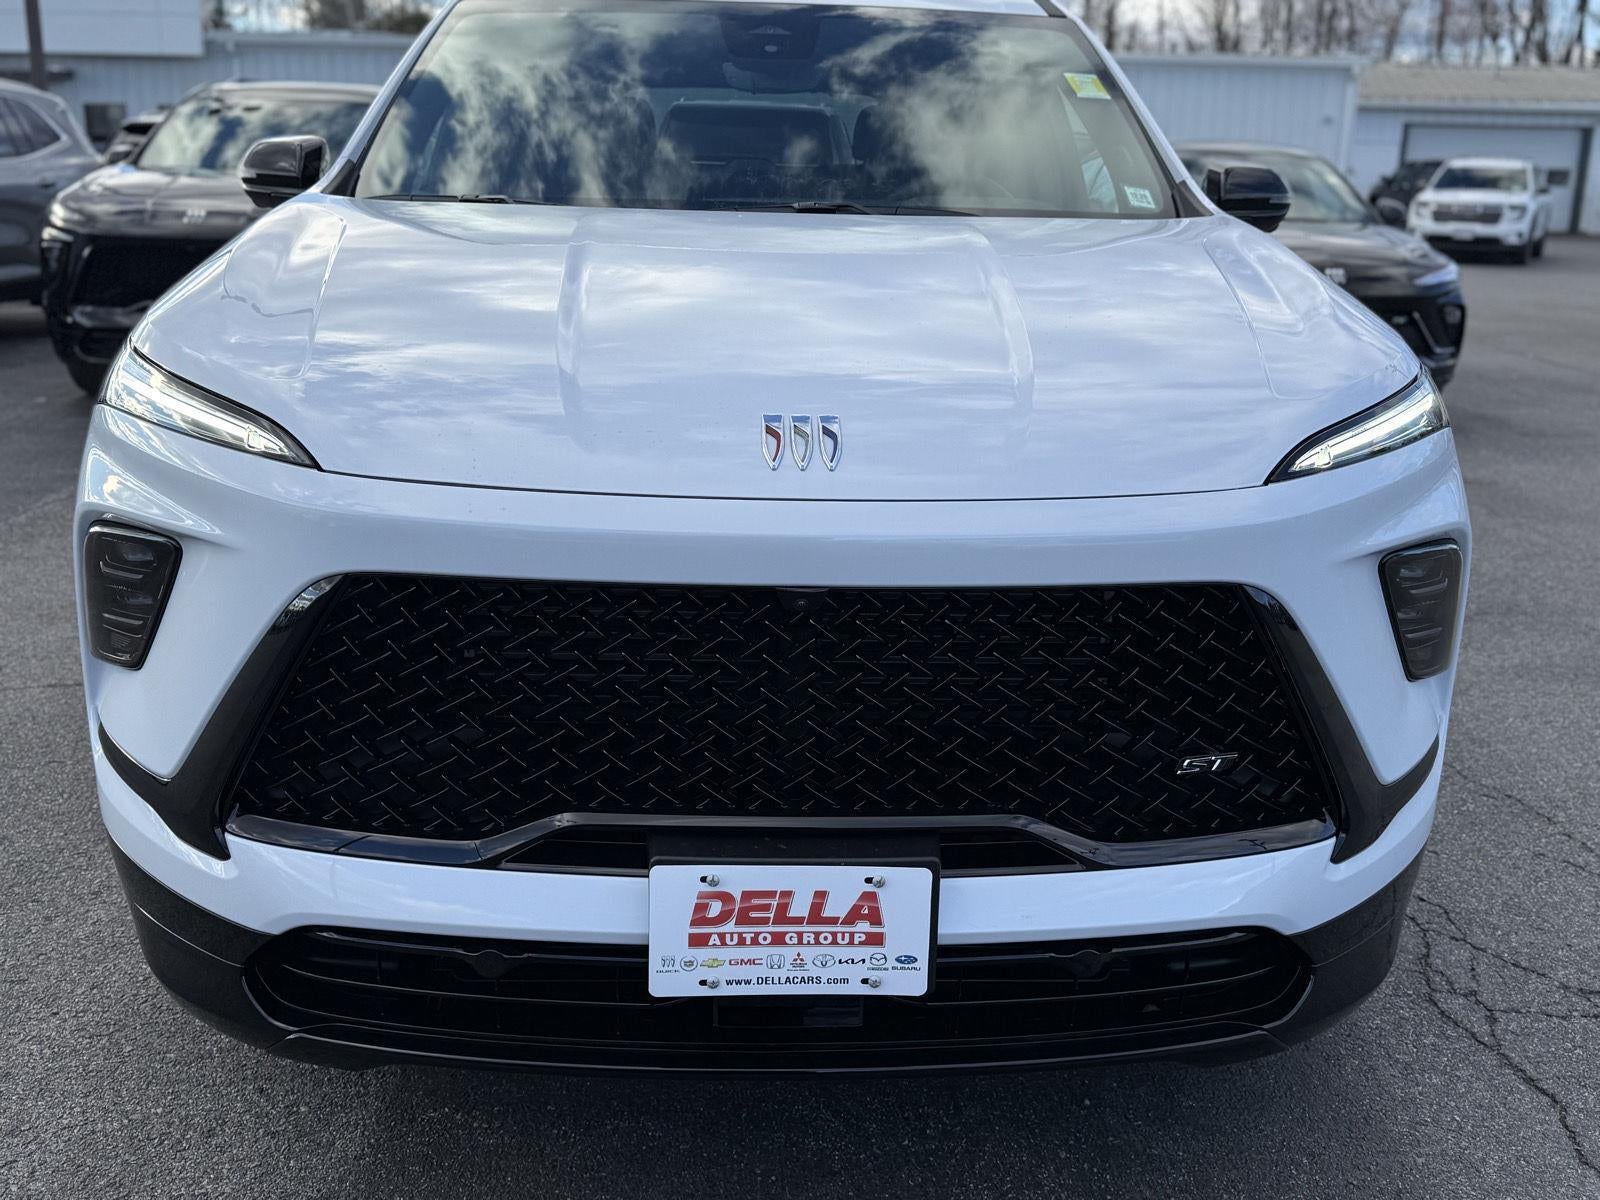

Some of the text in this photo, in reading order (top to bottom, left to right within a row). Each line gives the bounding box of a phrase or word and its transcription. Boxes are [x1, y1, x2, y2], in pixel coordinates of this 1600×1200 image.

[689, 890, 885, 928] DELLA
[708, 933, 866, 946] AUTO GROUP
[729, 958, 763, 966] GMC
[725, 976, 849, 986] www.DELLACARS.com
